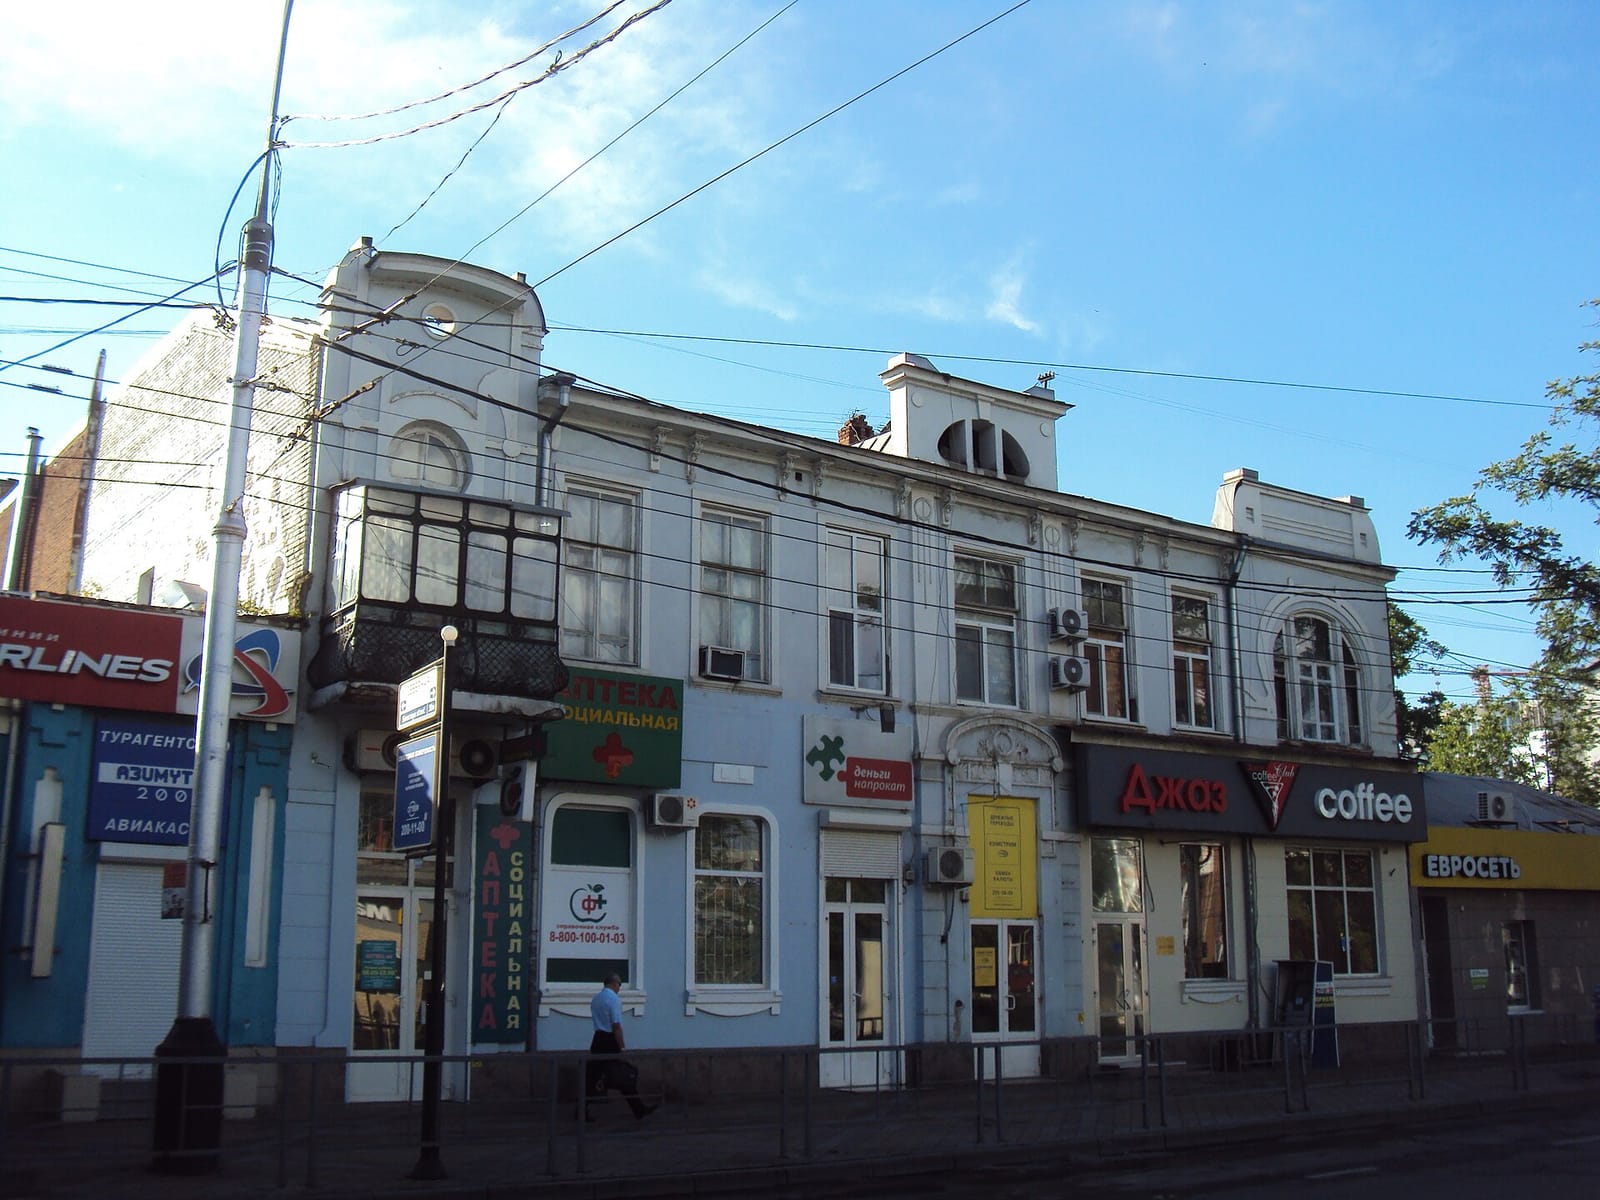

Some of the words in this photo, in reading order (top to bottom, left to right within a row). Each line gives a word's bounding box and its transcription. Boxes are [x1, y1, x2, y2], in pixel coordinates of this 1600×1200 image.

[556, 676, 679, 710] ПТЕКА
[563, 705, 679, 730] ОЦИАЛЬНАЯ
[853, 765, 891, 780] деньги
[853, 780, 906, 793] напрокат
[1120, 763, 1228, 815] Джаз
[1315, 782, 1413, 823] coffee
[1425, 854, 1521, 879] ЕВРОСЕТЬ
[479, 851, 500, 1029] АПТЕКА
[506, 851, 525, 1030] СОЦИАЛЬНАЯ
[549, 931, 626, 944] 8-800-100-01-03
